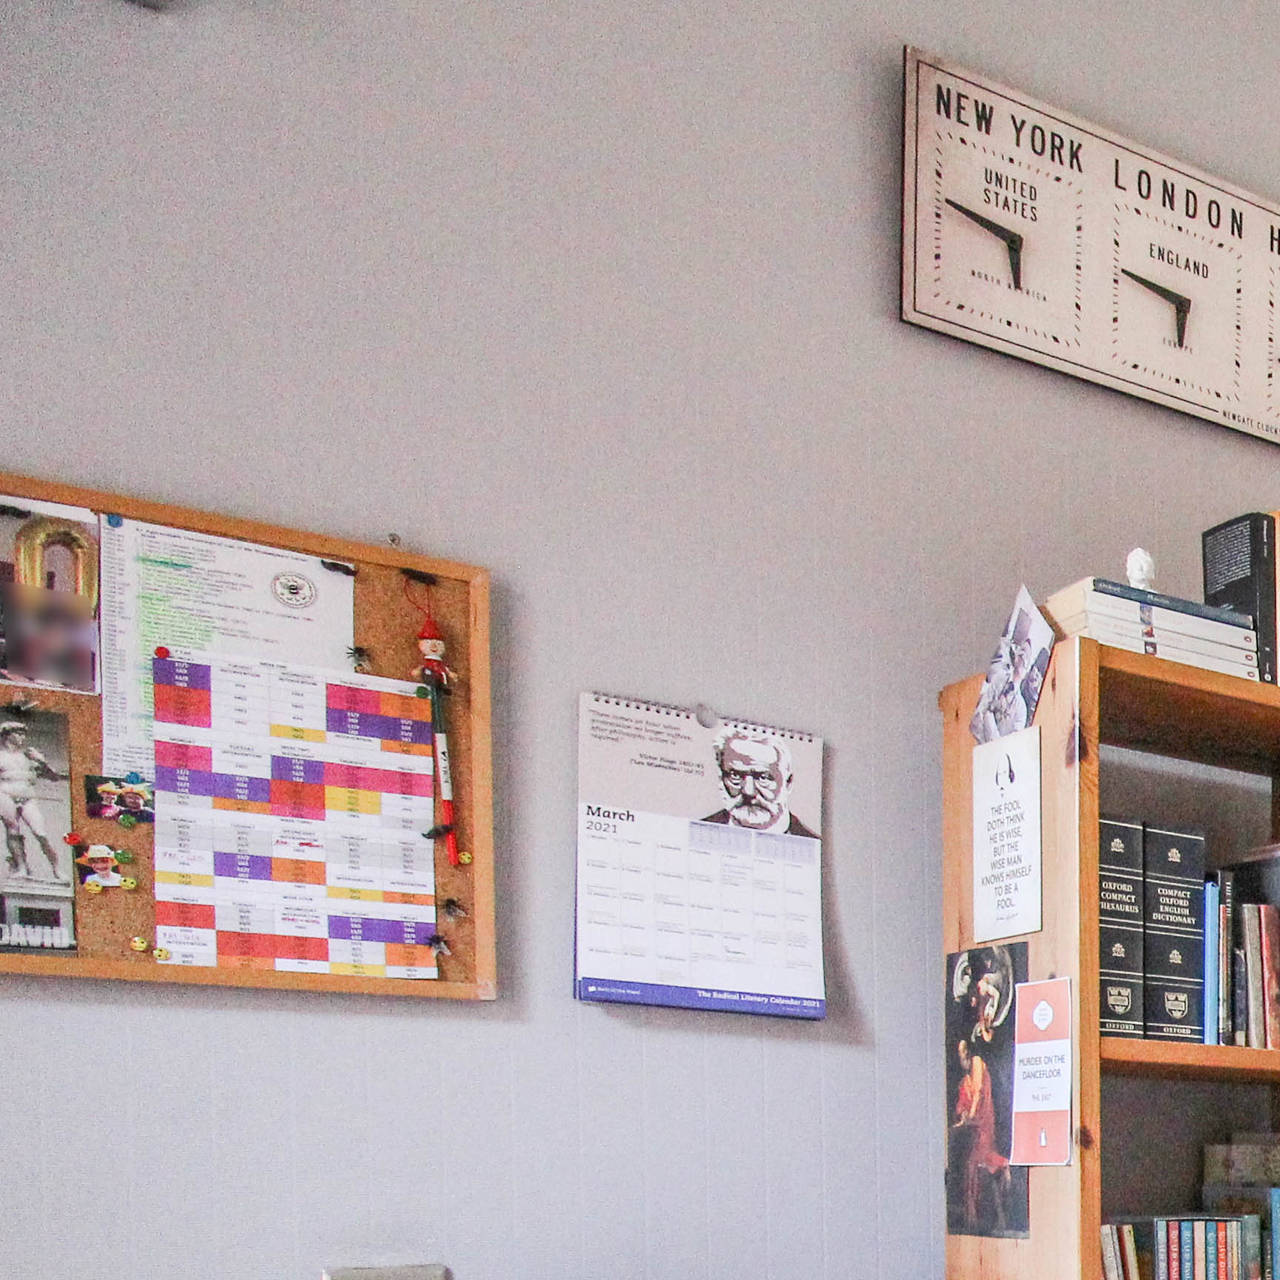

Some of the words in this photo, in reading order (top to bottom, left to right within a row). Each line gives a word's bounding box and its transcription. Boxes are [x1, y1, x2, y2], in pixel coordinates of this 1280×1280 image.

[936, 83, 994, 136] NEW
[1011, 113, 1083, 173] YORK
[984, 167, 1037, 201] UNITED
[984, 188, 1038, 222] STATES
[1114, 158, 1244, 239] LONDON
[1149, 243, 1209, 279] ENGLAND
[586, 805, 635, 822] March
[991, 804, 1002, 816] THE
[1004, 800, 1021, 813] FOOL
[586, 820, 618, 833] 2021
[987, 819, 1005, 831] DOTH
[1006, 813, 1024, 825] THINK
[989, 832, 998, 844] HE
[999, 831, 1005, 842] IS
[993, 844, 1005, 857] BUT
[1007, 841, 1018, 852] THE
[990, 858, 1005, 871] WISE
[1007, 855, 1022, 866] MAN
[981, 871, 1004, 887] KNOWS
[1006, 865, 1032, 880] HIMSELF
[994, 885, 1003, 897] TO
[1004, 883, 1012, 894] BE
[1013, 882, 1018, 892] A
[1102, 881, 1133, 892] OXFORD
[1157, 888, 1191, 898] COMPACT
[997, 898, 1015, 909] FOOL
[1101, 892, 1136, 903] COMPACT
[1159, 896, 1189, 907] OXFORD
[1159, 905, 1189, 915] ENGLISH
[1152, 913, 1196, 925] DICTIONARY
[697, 990, 712, 998] The
[802, 998, 820, 1007] 2021
[1105, 1022, 1134, 1030] OXFORD
[1163, 1026, 1191, 1035] OXFORD
[1019, 1056, 1043, 1067] MURDER
[1044, 1055, 1053, 1065] ON
[1054, 1054, 1065, 1064] THE
[1022, 1068, 1062, 1081] DANCEFLOOR
